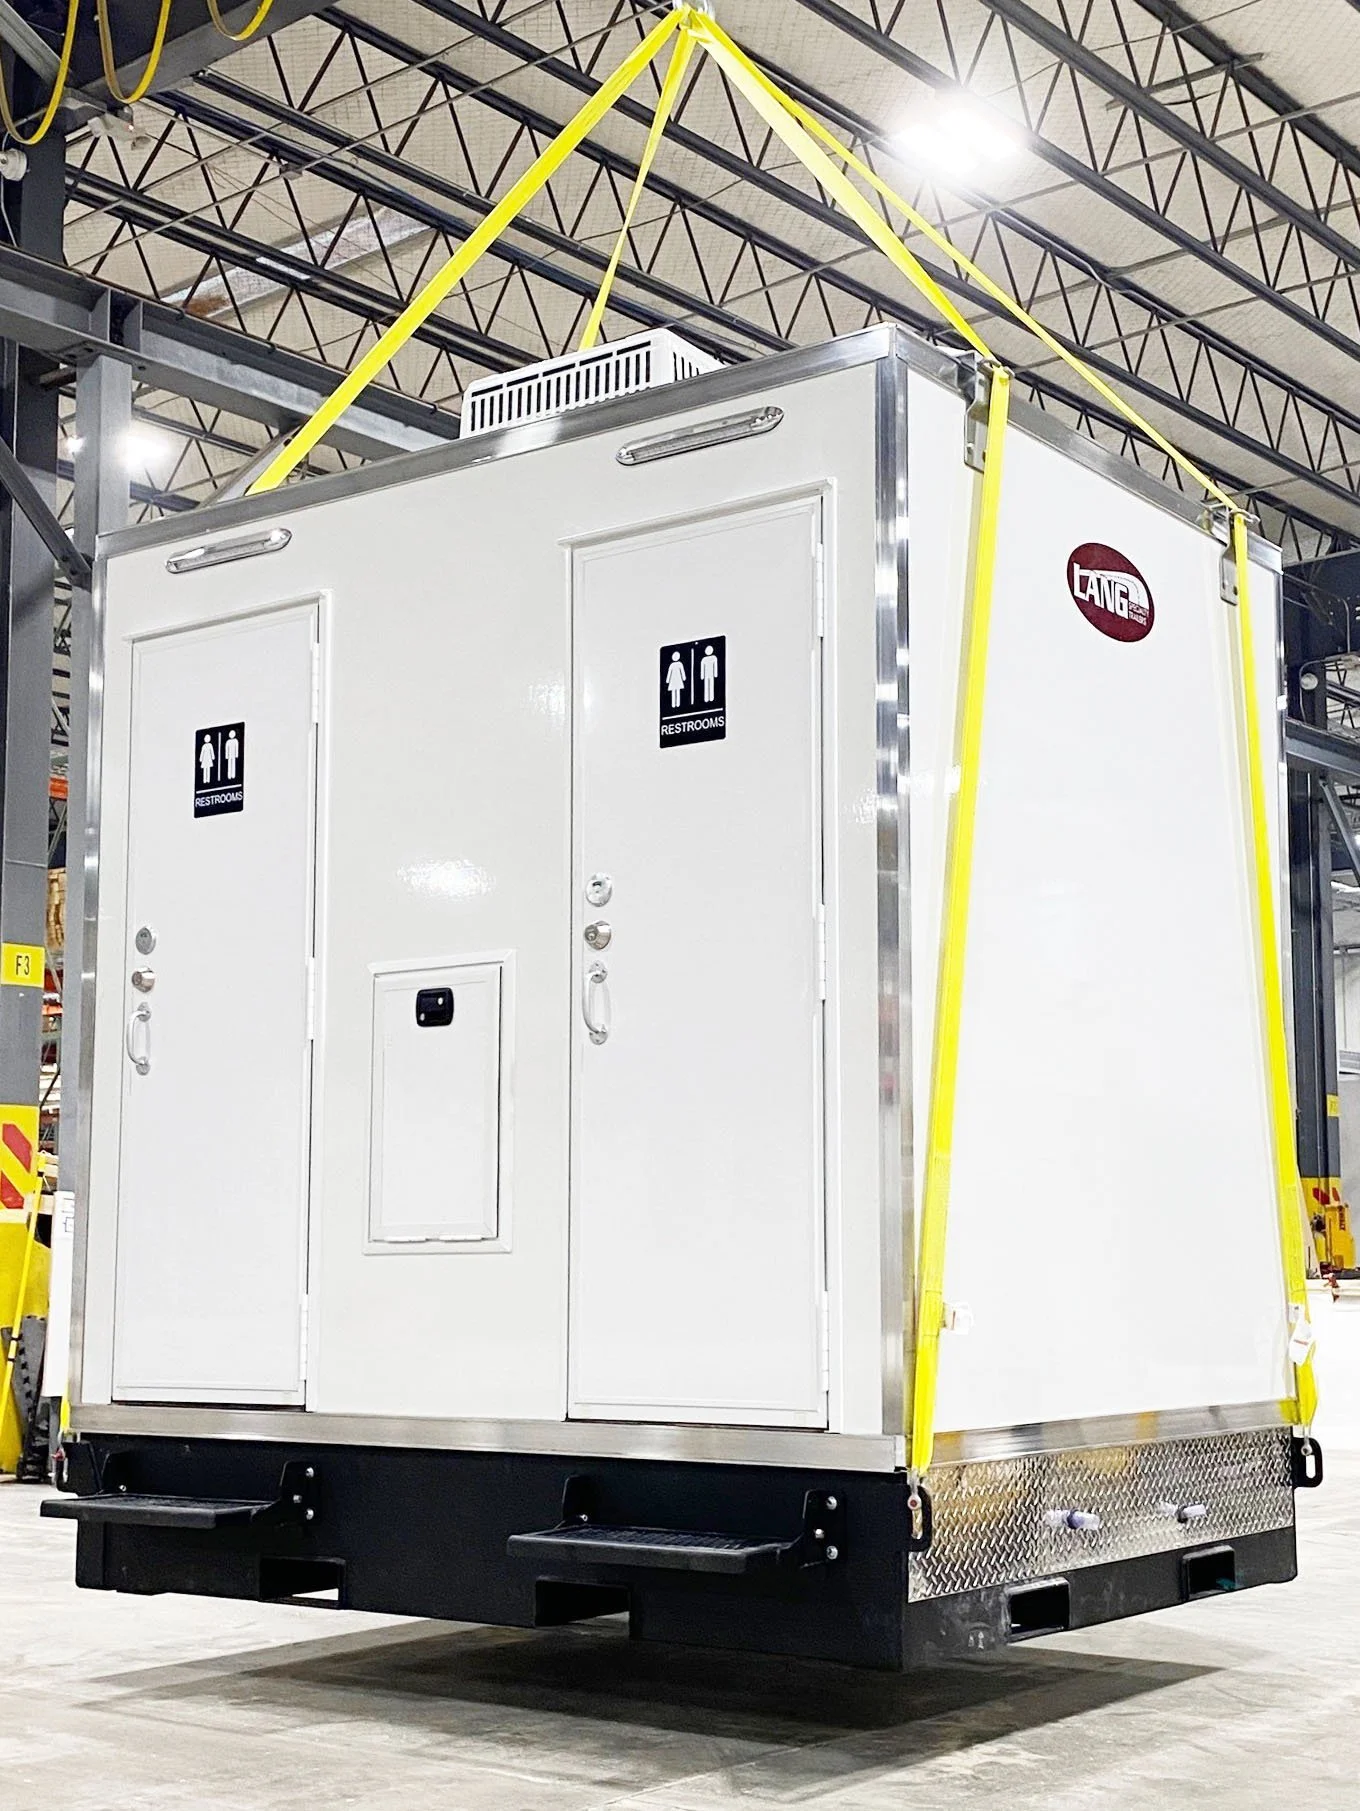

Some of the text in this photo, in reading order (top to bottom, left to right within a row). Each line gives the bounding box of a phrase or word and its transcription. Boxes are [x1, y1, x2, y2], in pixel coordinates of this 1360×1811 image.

[1073, 562, 1129, 619] LANG
[661, 716, 725, 736] RESTROOMS
[195, 791, 243, 808] RESTROOMS
[16, 954, 30, 976] F3
